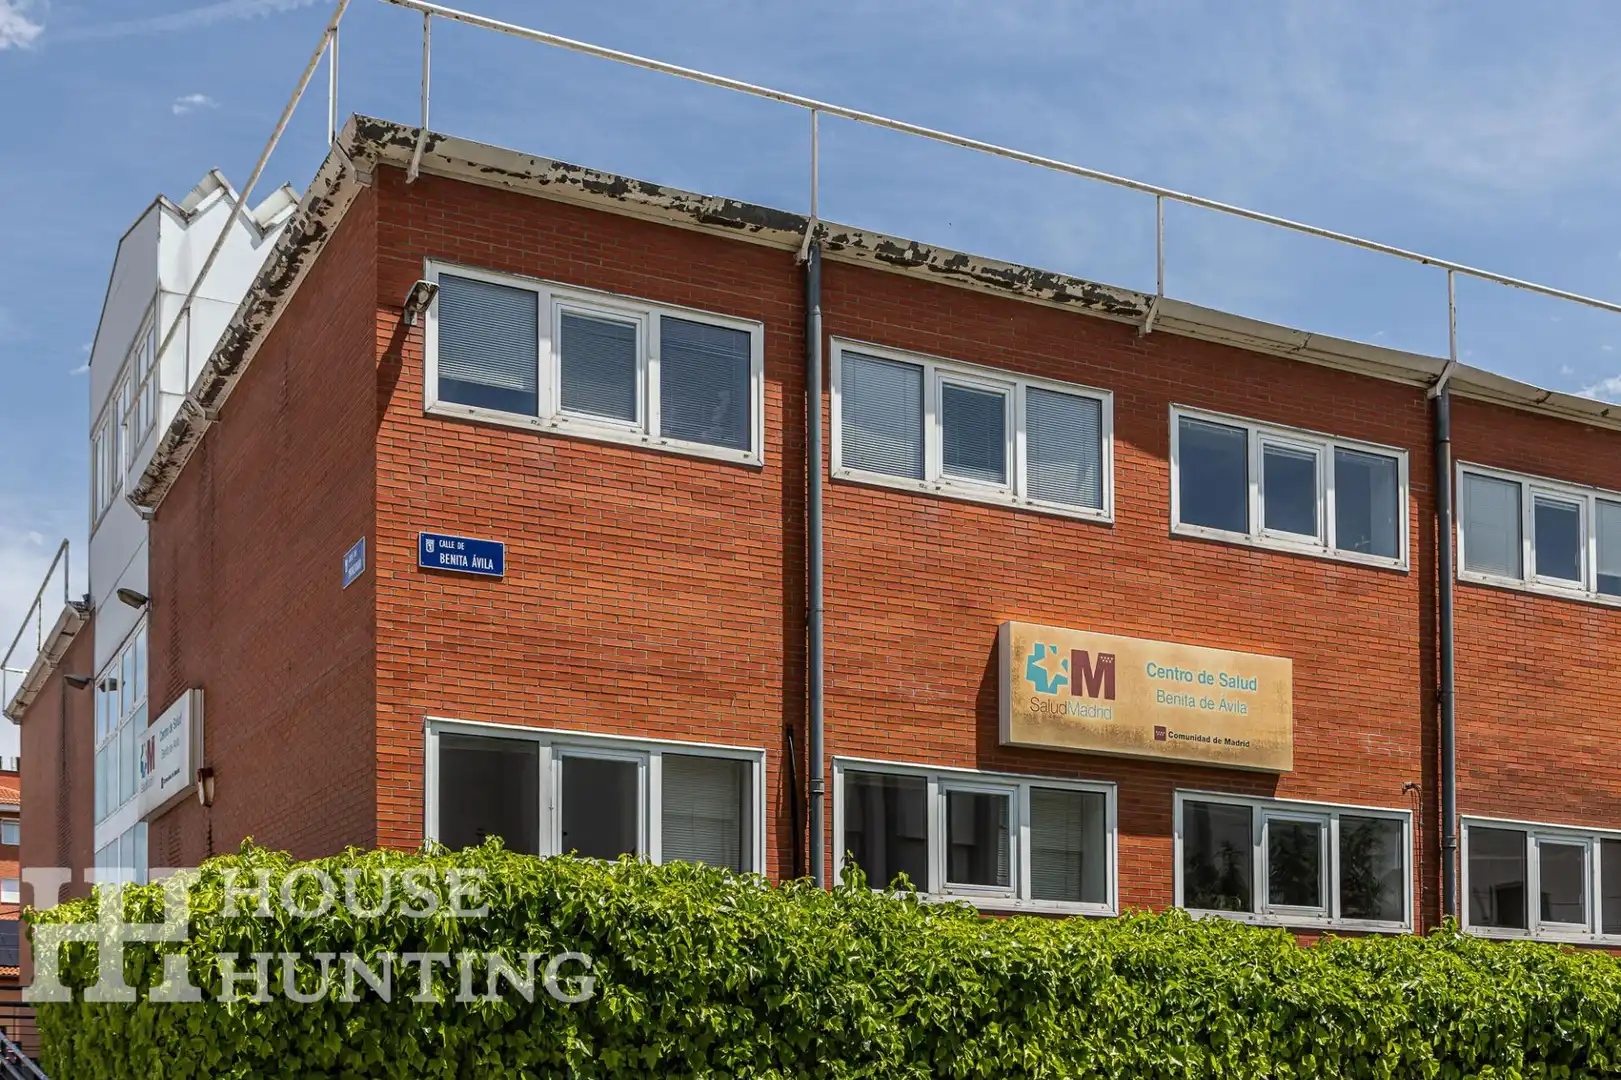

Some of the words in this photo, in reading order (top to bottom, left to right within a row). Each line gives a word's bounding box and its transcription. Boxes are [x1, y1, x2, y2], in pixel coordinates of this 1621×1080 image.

[439, 540, 455, 549] CALLE
[457, 542, 465, 550] DE
[440, 553, 468, 567] BENITA
[472, 554, 494, 570] ÁVILA
[1071, 649, 1115, 700] M
[1146, 662, 1193, 682] Centro
[1198, 670, 1214, 685] de
[1219, 672, 1257, 691] Salud
[1030, 697, 1112, 720] SaludMadrid
[1156, 689, 1196, 708] Benita
[1199, 696, 1215, 710] de
[1219, 695, 1247, 714] Ávila
[1168, 731, 1211, 743] Comunidad
[1212, 736, 1222, 745] de
[1224, 738, 1250, 748] Madrid
